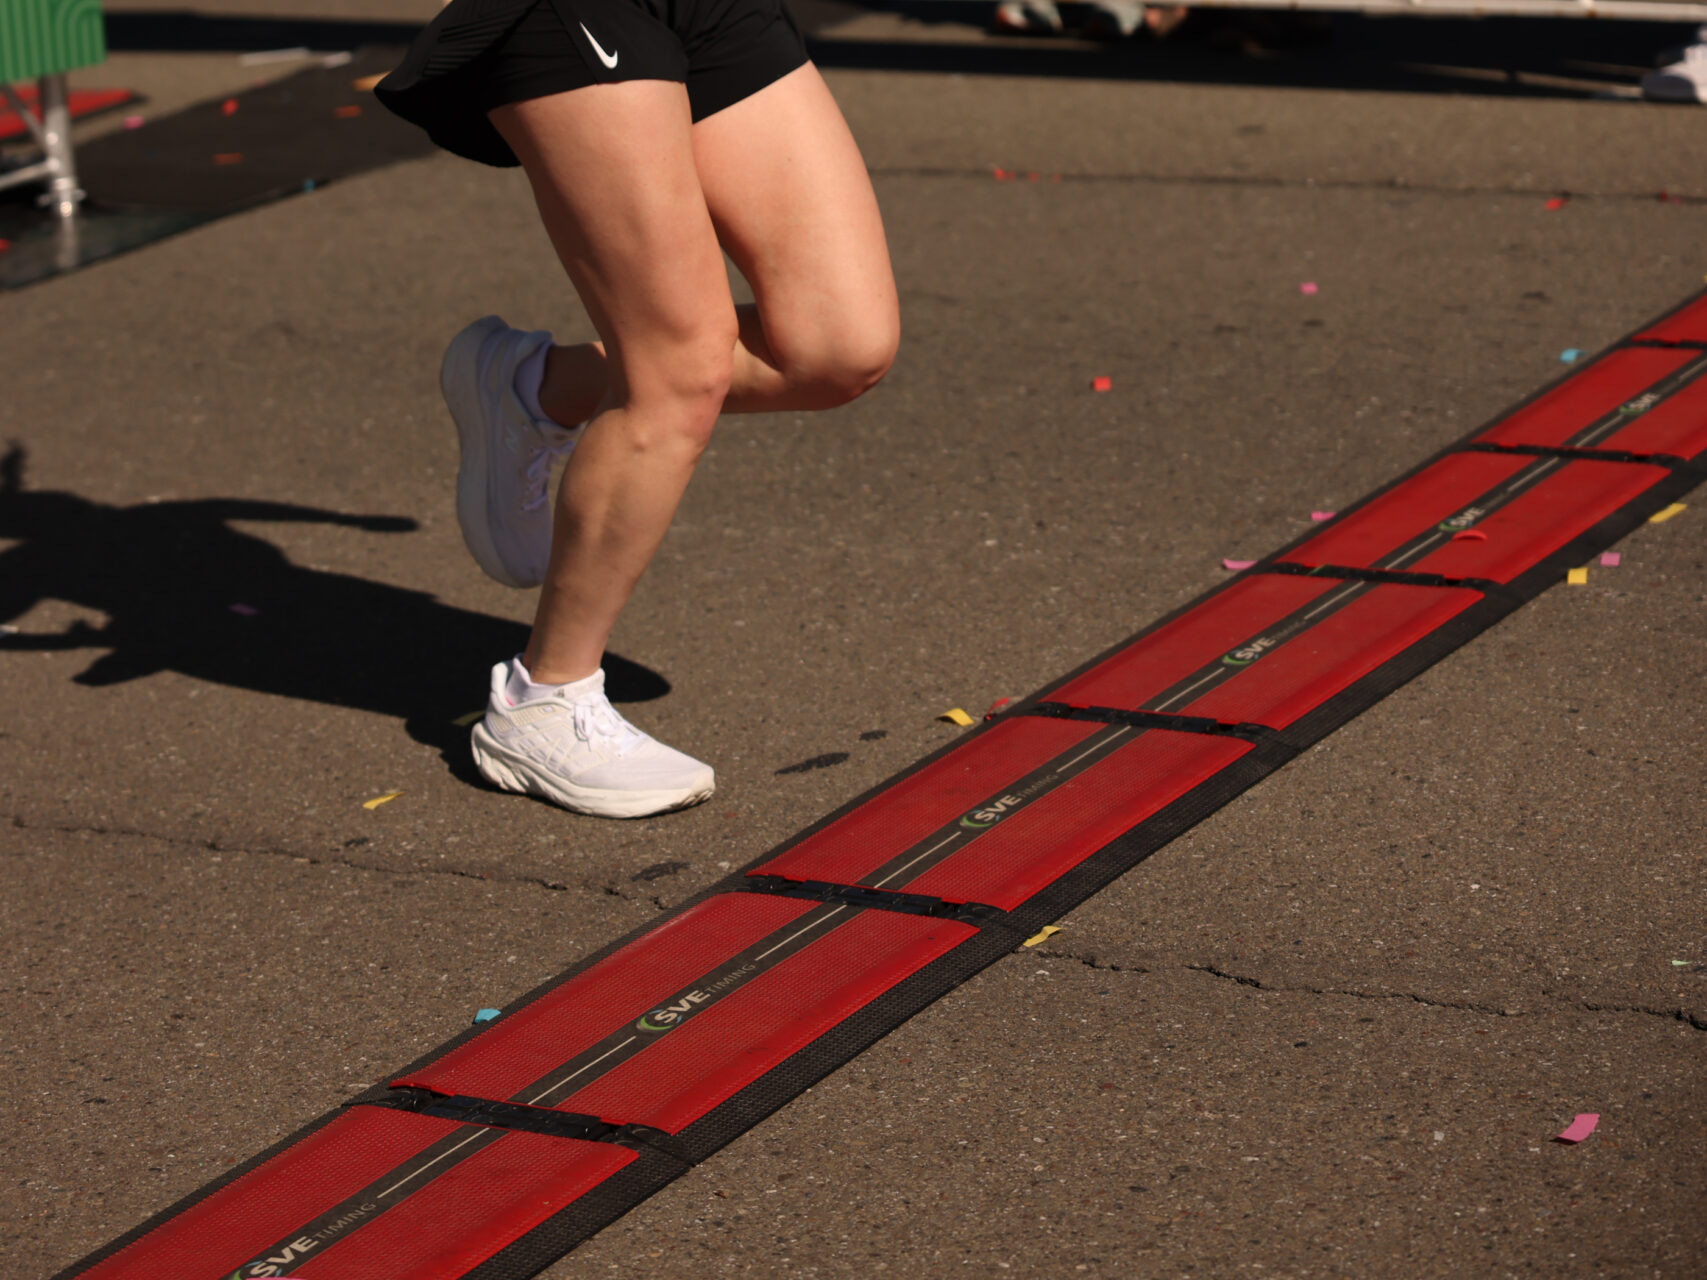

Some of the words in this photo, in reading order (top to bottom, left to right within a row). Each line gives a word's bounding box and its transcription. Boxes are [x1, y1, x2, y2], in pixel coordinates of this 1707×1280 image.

[1234, 637, 1277, 660] SVE
[973, 795, 1023, 822] SVE
[653, 989, 712, 1024] SVE
[703, 962, 757, 994] TIMING
[250, 1235, 319, 1279] SVE
[311, 1201, 377, 1240] TIMING
